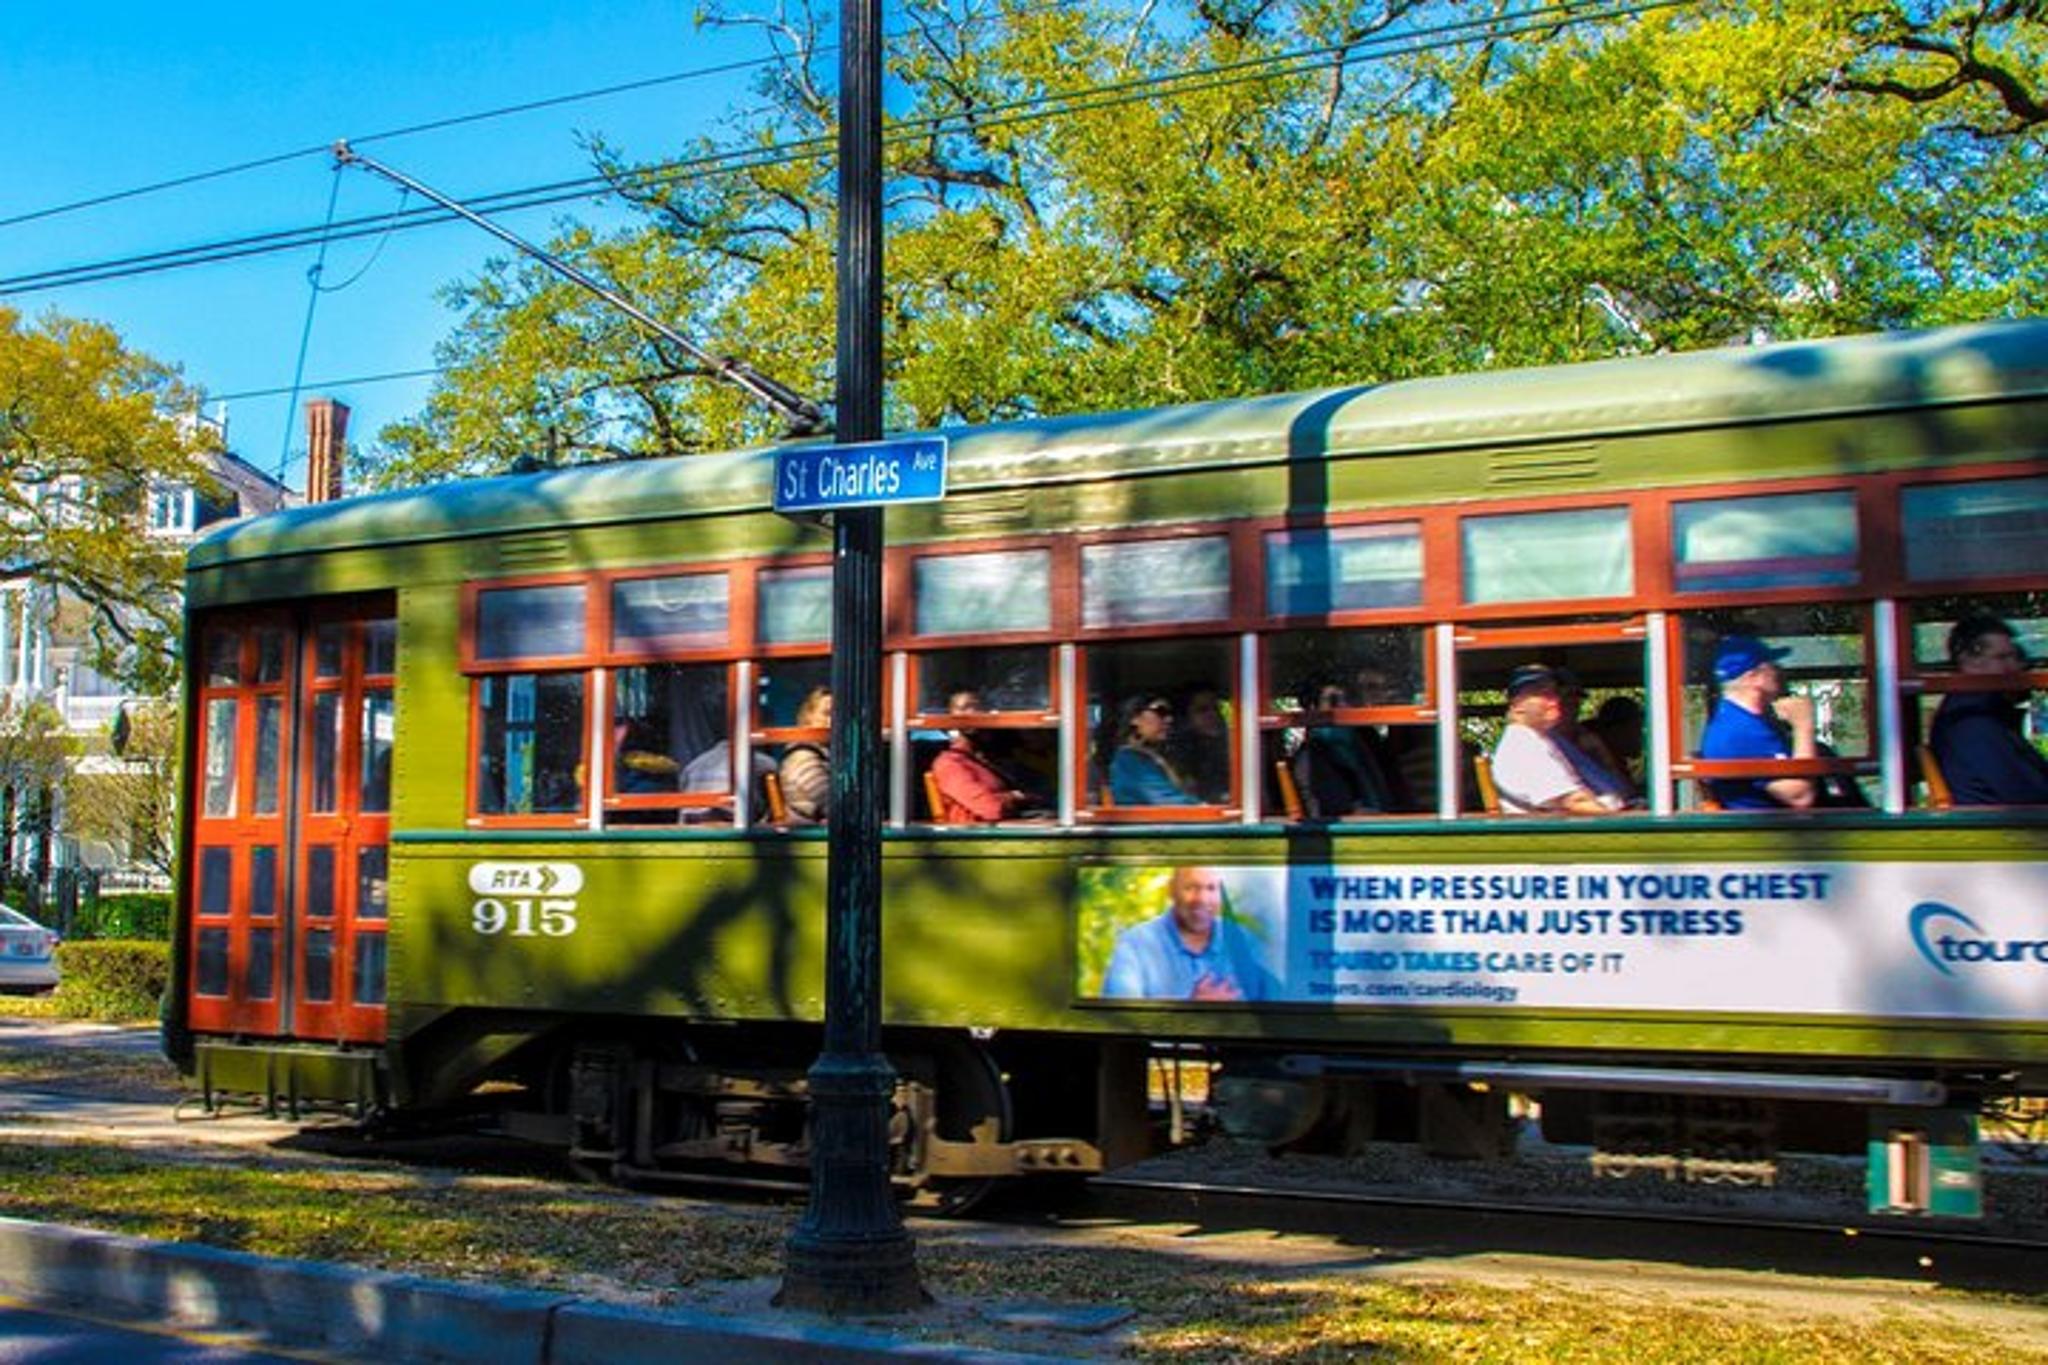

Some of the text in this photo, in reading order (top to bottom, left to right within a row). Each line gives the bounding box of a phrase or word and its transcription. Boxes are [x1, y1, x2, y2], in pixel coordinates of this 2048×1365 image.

[785, 450, 937, 499] St Charles Ave
[492, 870, 531, 888] RTA
[1309, 872, 1830, 900] WHEN PRESSURE IN YOUR CHEST
[471, 898, 577, 936] 915
[1309, 909, 1743, 935] IS MORE THAN JUST STRESS
[1402, 952, 1480, 971] TAKES
[1486, 953, 1553, 973] CARE
[1561, 953, 1595, 973] OF
[1602, 954, 1625, 973] IT
